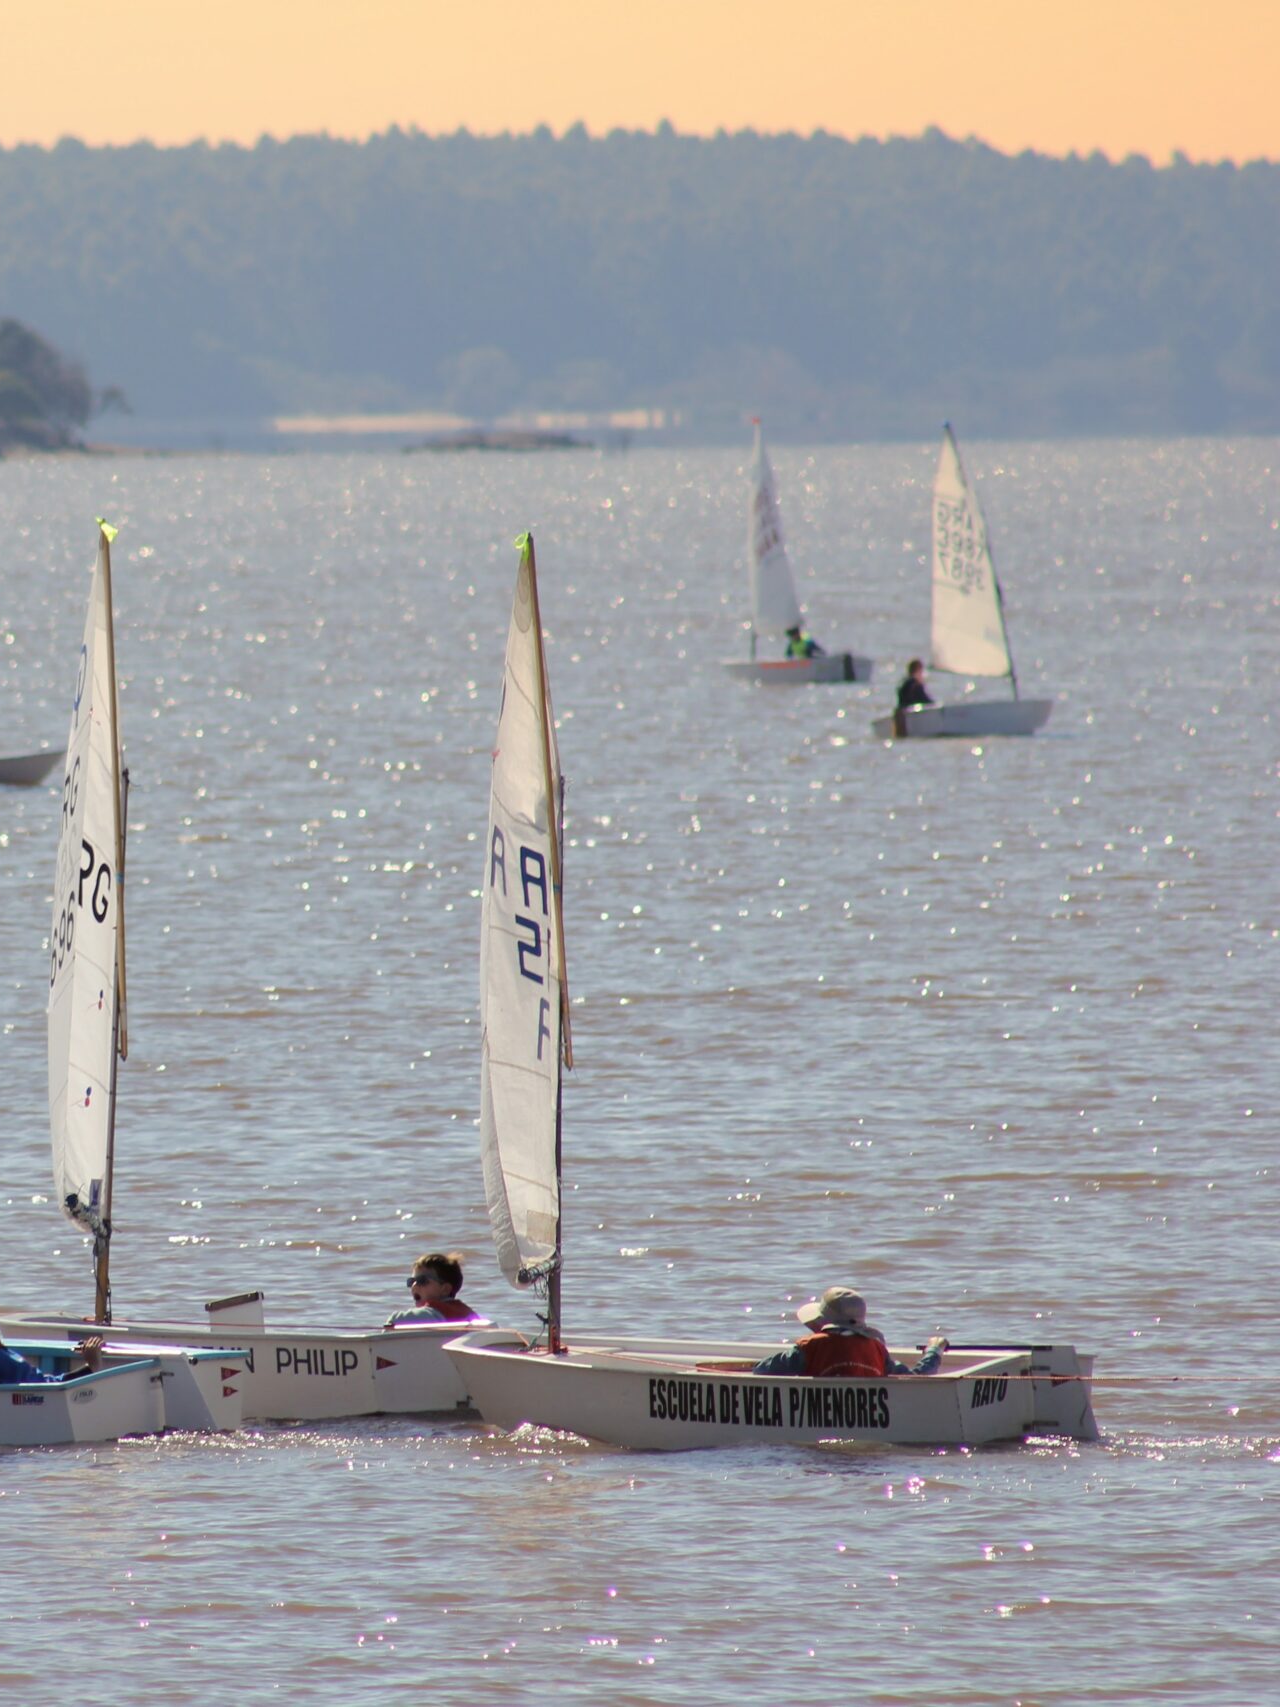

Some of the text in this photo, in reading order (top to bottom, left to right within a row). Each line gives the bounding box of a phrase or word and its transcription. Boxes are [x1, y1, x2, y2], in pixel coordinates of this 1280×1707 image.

[276, 1347, 358, 1376] PHILIP
[649, 1378, 716, 1424] ESCUELA
[719, 1384, 740, 1425] DE
[742, 1385, 783, 1427] VELA
[971, 1372, 1008, 1409] RAYO
